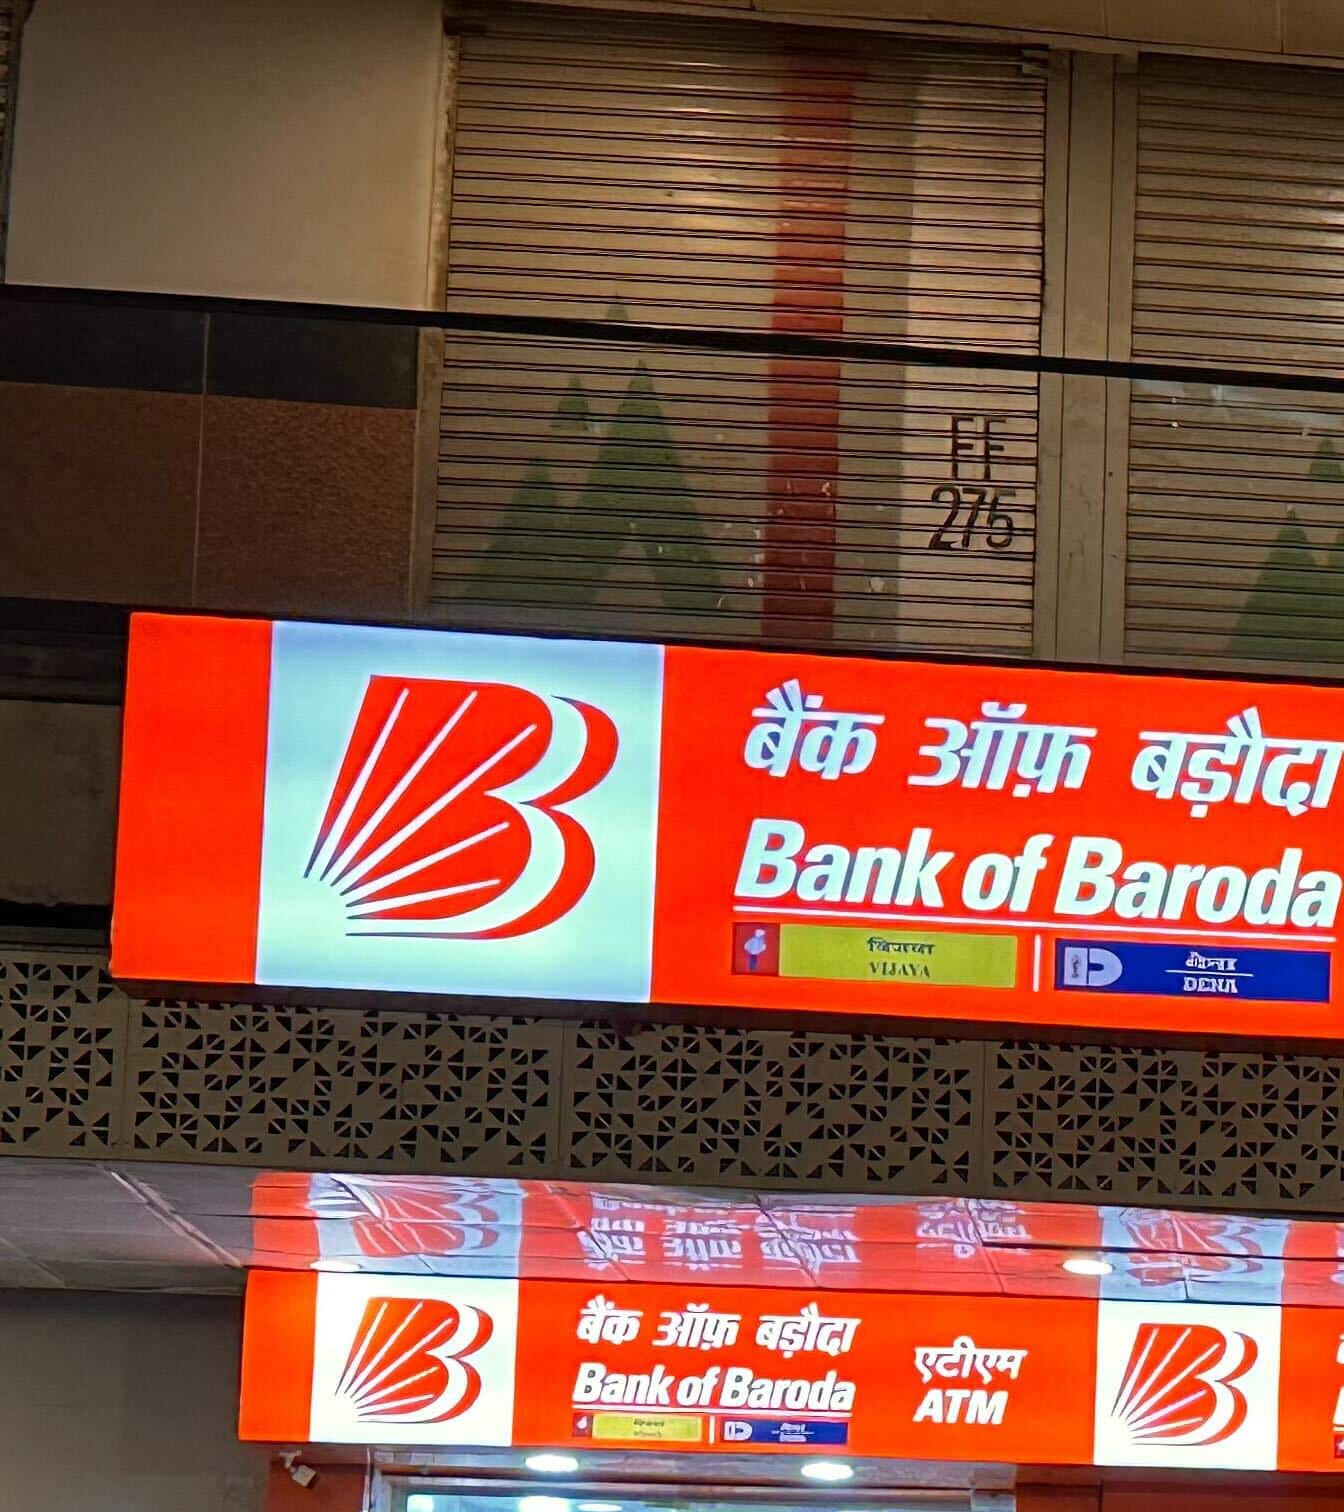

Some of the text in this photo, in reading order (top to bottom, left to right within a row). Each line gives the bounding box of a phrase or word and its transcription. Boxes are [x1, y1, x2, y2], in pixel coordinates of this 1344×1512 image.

[952, 415, 1006, 480] FF
[929, 484, 1017, 550] 275
[744, 679, 885, 780] बैंक
[908, 702, 1097, 797] ऑफ़
[734, 818, 1342, 928] Bank of Baroda
[869, 961, 931, 978] VIJAYA
[577, 1294, 861, 1359] बैंक ऑफ़ बड़ौदा
[572, 1362, 856, 1411] Bank of Baroda
[914, 1336, 1028, 1384] एटीएम
[913, 1389, 1009, 1425] ATM
